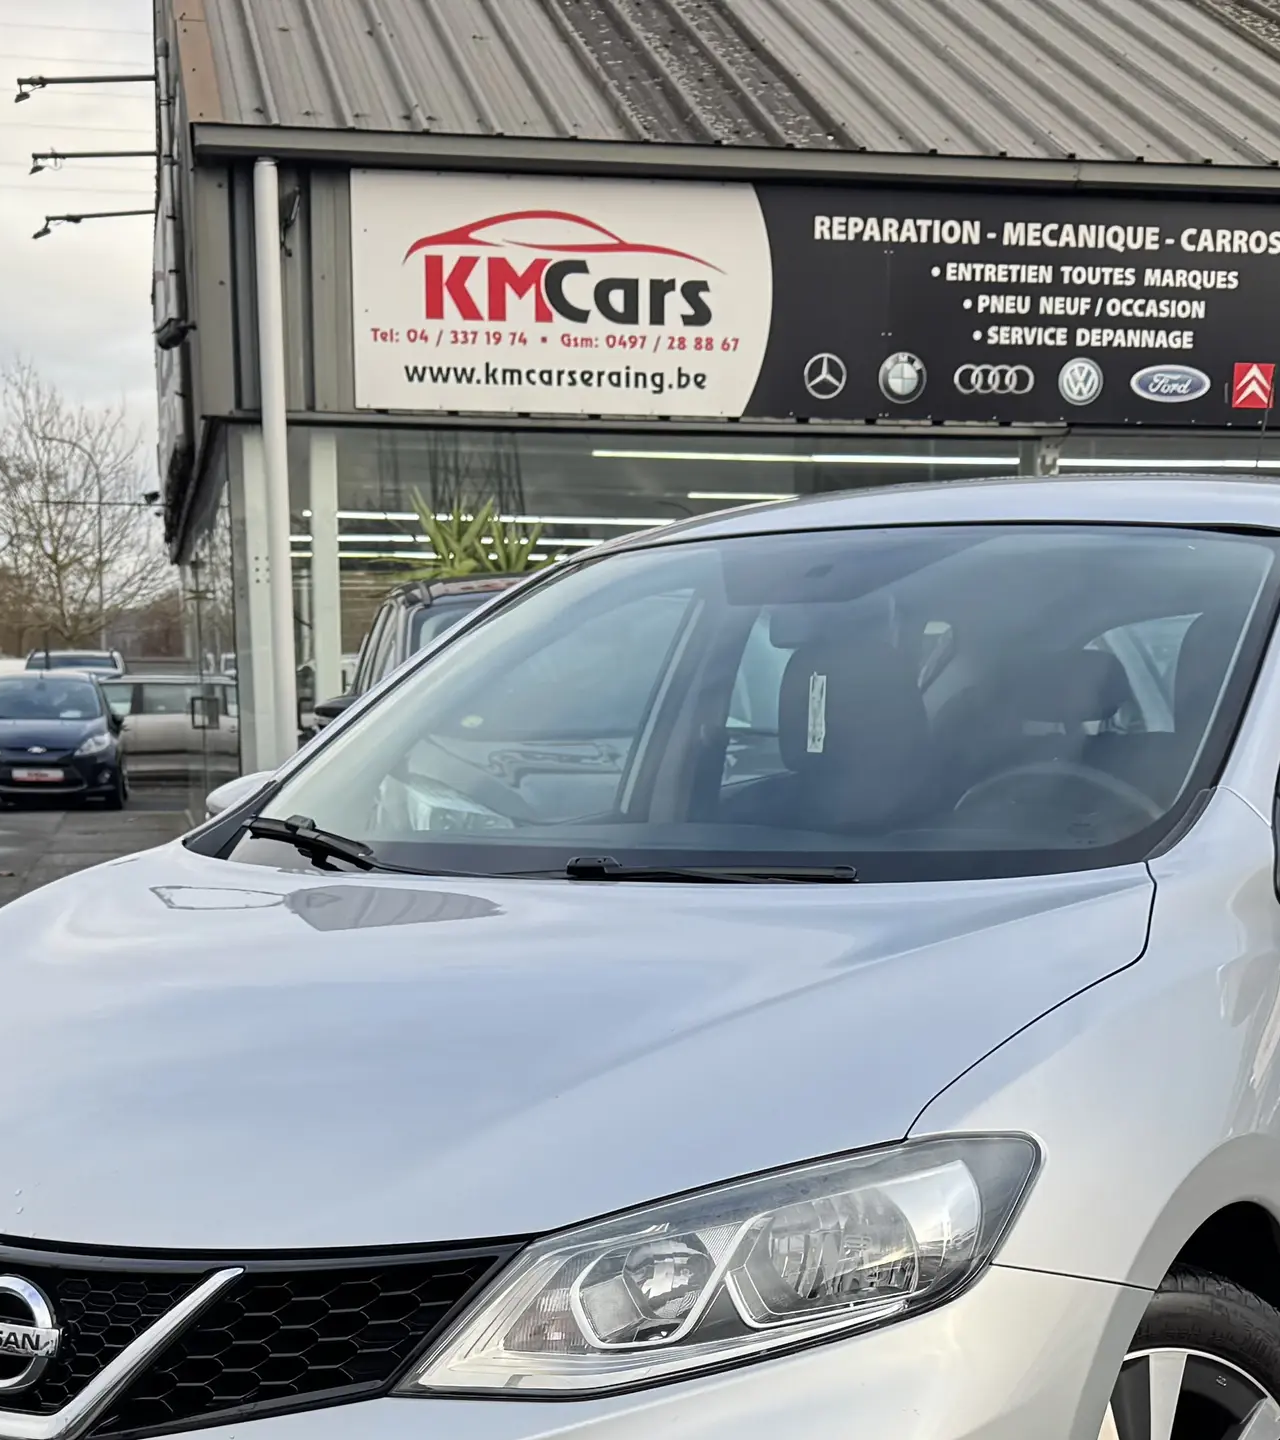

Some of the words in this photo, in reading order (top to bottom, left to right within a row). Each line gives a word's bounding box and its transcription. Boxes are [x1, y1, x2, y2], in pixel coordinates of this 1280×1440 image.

[814, 215, 981, 245] REPARATION
[1003, 221, 1160, 252] MECANIQUE
[945, 262, 1053, 284] ENTRETIEN
[1060, 265, 1136, 287] TOUTES
[1143, 268, 1239, 290] MARQUES
[424, 254, 713, 327] KMCars
[977, 294, 1031, 315] PNEU
[370, 328, 400, 344] Tel:
[406, 329, 429, 344] 04
[450, 330, 479, 345] 337
[485, 330, 502, 346] 19
[509, 331, 528, 347] 74
[560, 334, 600, 349] Gsm:
[605, 334, 646, 350] 0497
[667, 336, 687, 351] 28
[694, 336, 714, 351] 88
[721, 337, 740, 352] 67
[986, 325, 1068, 346] SERVICE
[1075, 327, 1194, 349] DEPANNAGE
[404, 361, 707, 395] www.kmcarseraing.be
[1148, 374, 1191, 395] Ford
